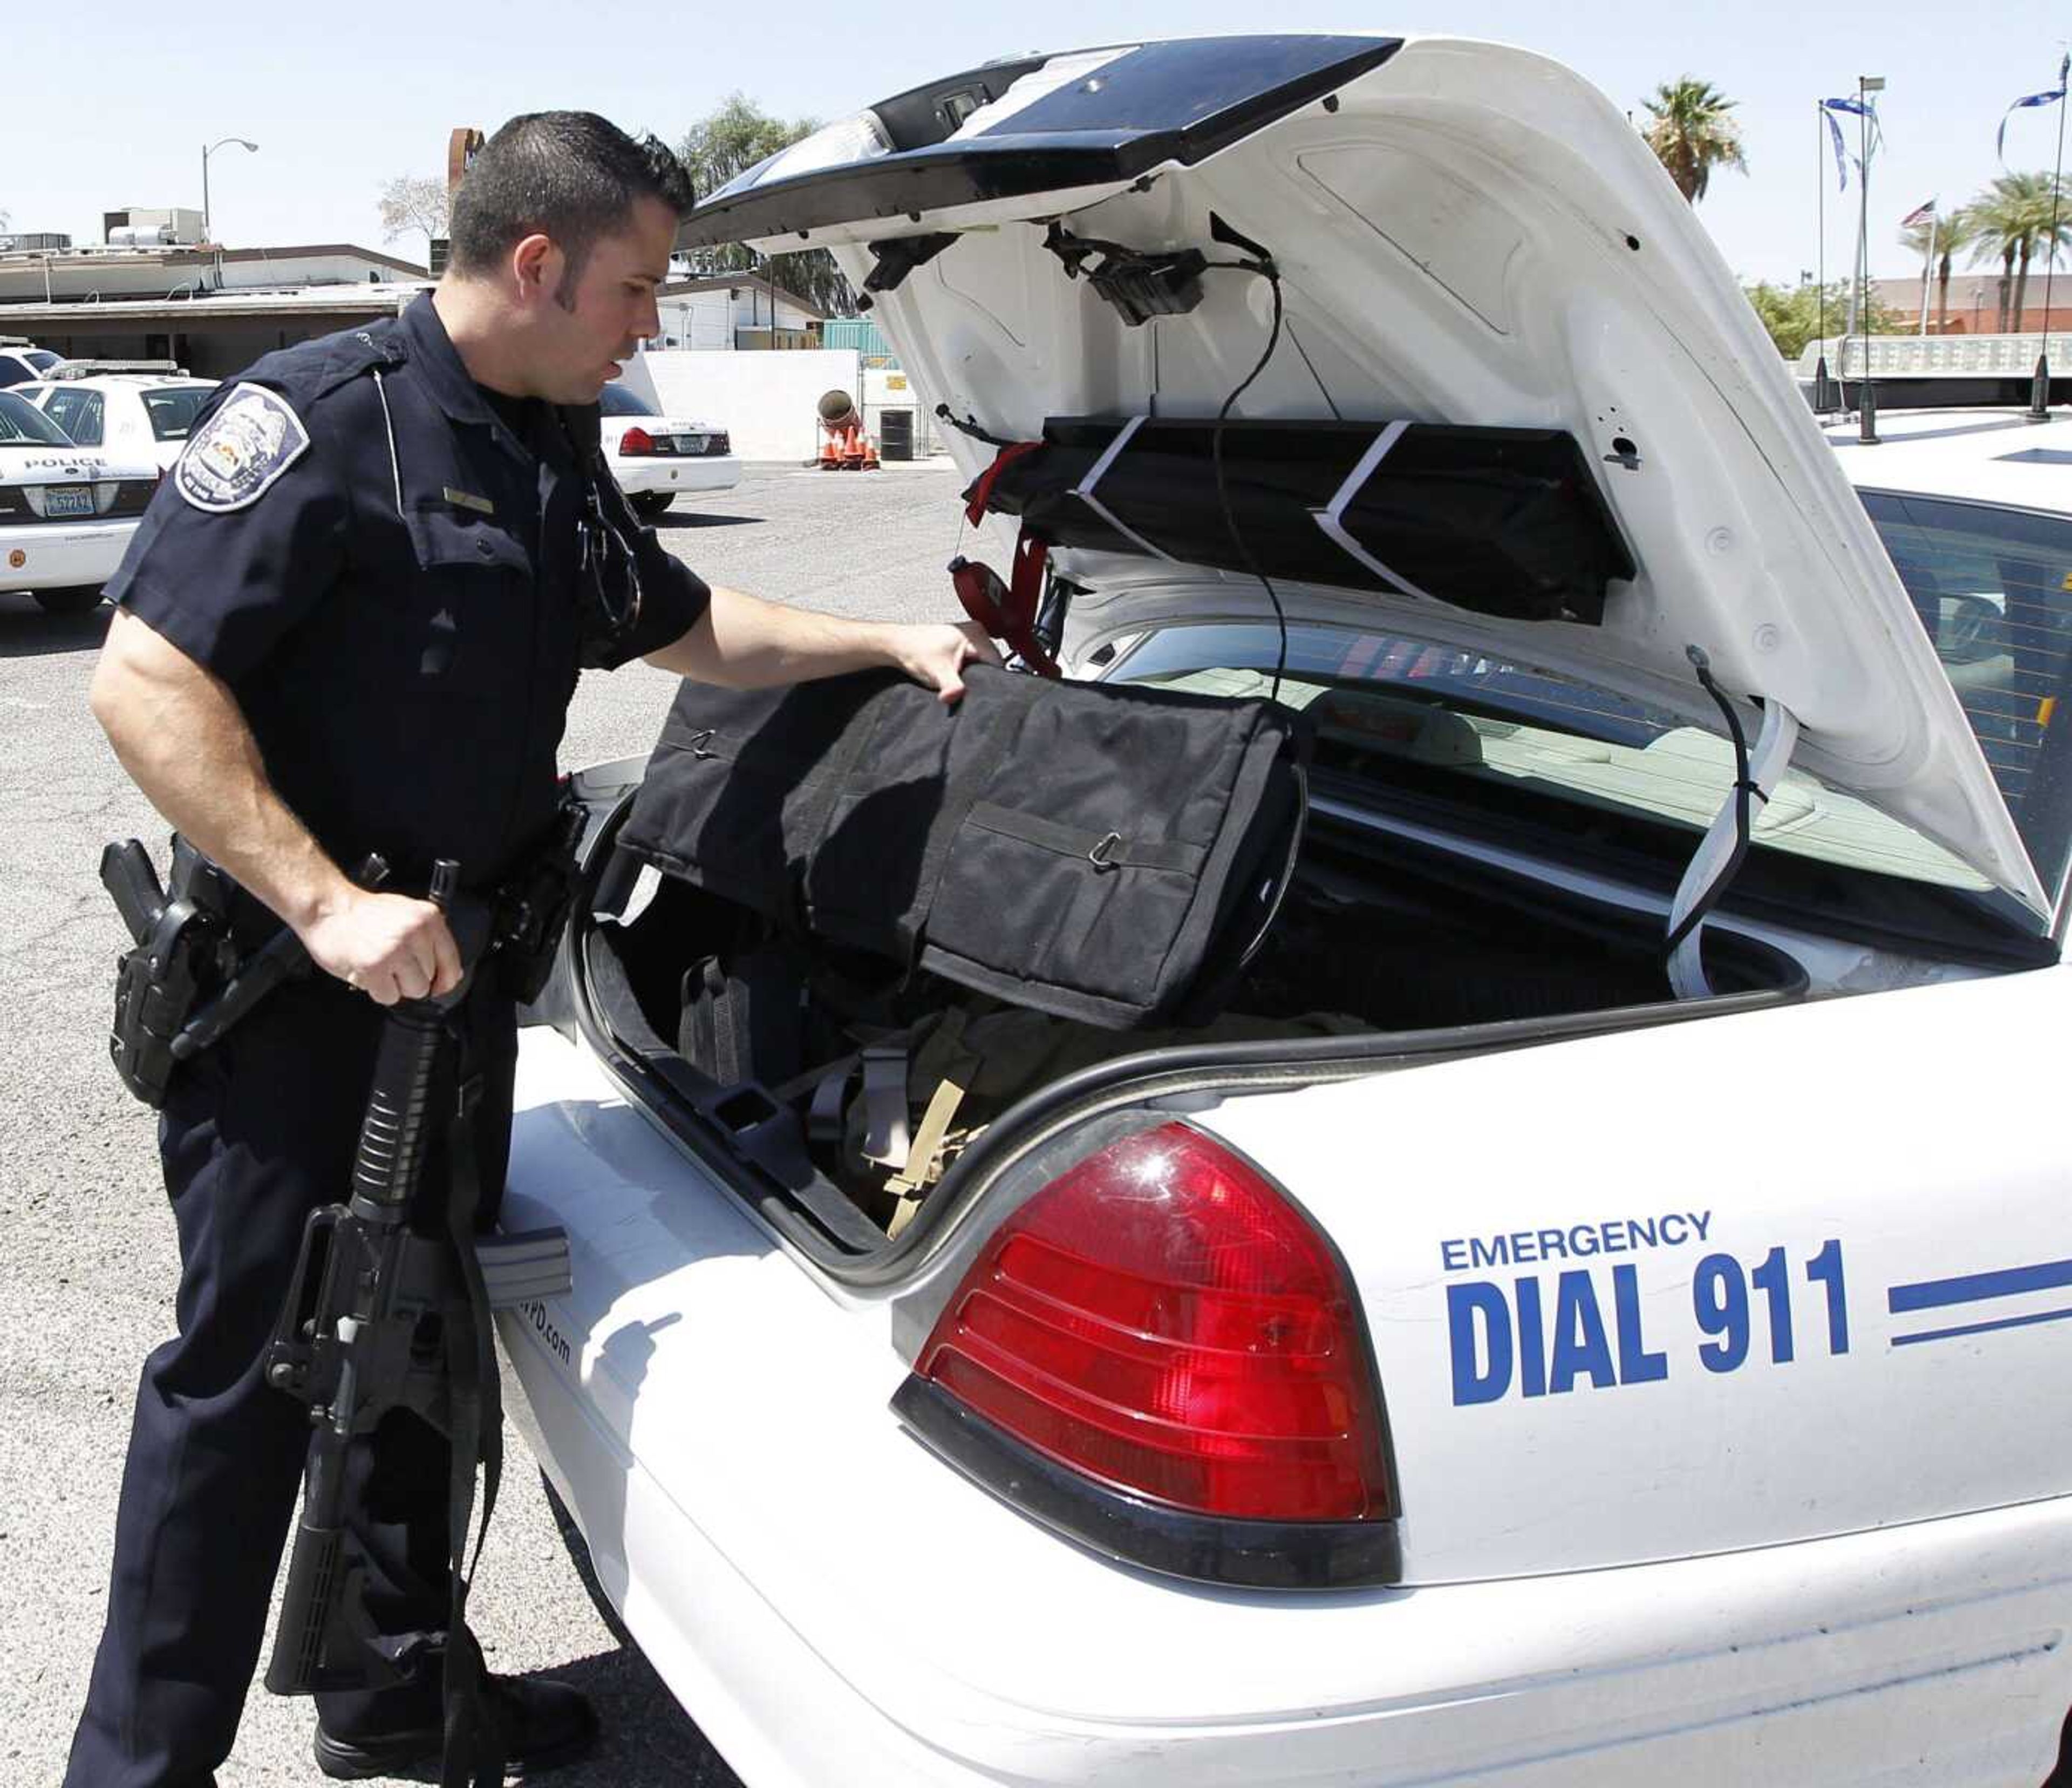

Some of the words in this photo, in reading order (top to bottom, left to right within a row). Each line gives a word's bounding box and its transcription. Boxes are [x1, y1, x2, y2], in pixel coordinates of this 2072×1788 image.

[25, 458, 107, 468] POLICE
[1441, 1211, 1711, 1270] EMERGENCY
[1446, 1263, 1668, 1406] DIAL
[1693, 1239, 1849, 1374] 911
